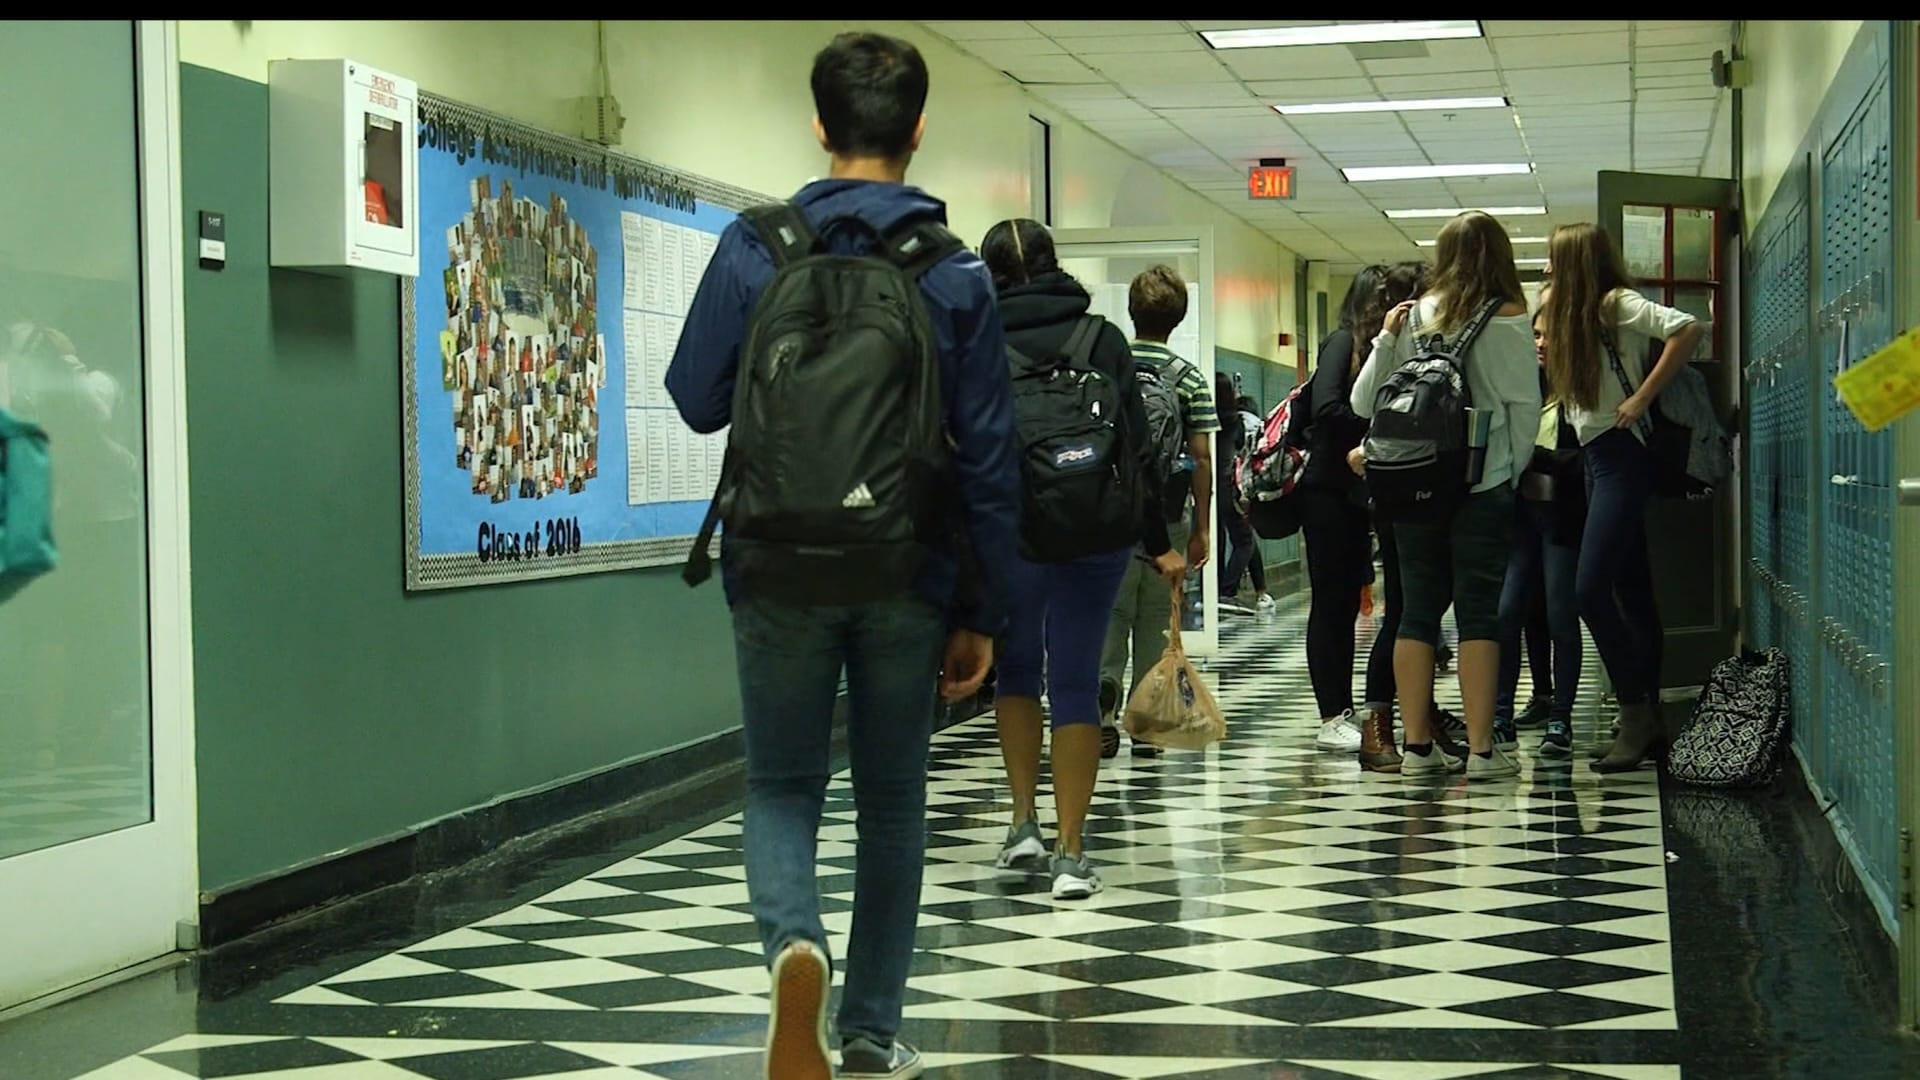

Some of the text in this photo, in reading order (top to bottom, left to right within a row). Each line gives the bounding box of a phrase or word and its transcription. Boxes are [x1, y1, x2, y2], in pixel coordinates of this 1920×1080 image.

[1250, 171, 1291, 198] EXIT
[478, 516, 581, 562] Class of 2016
